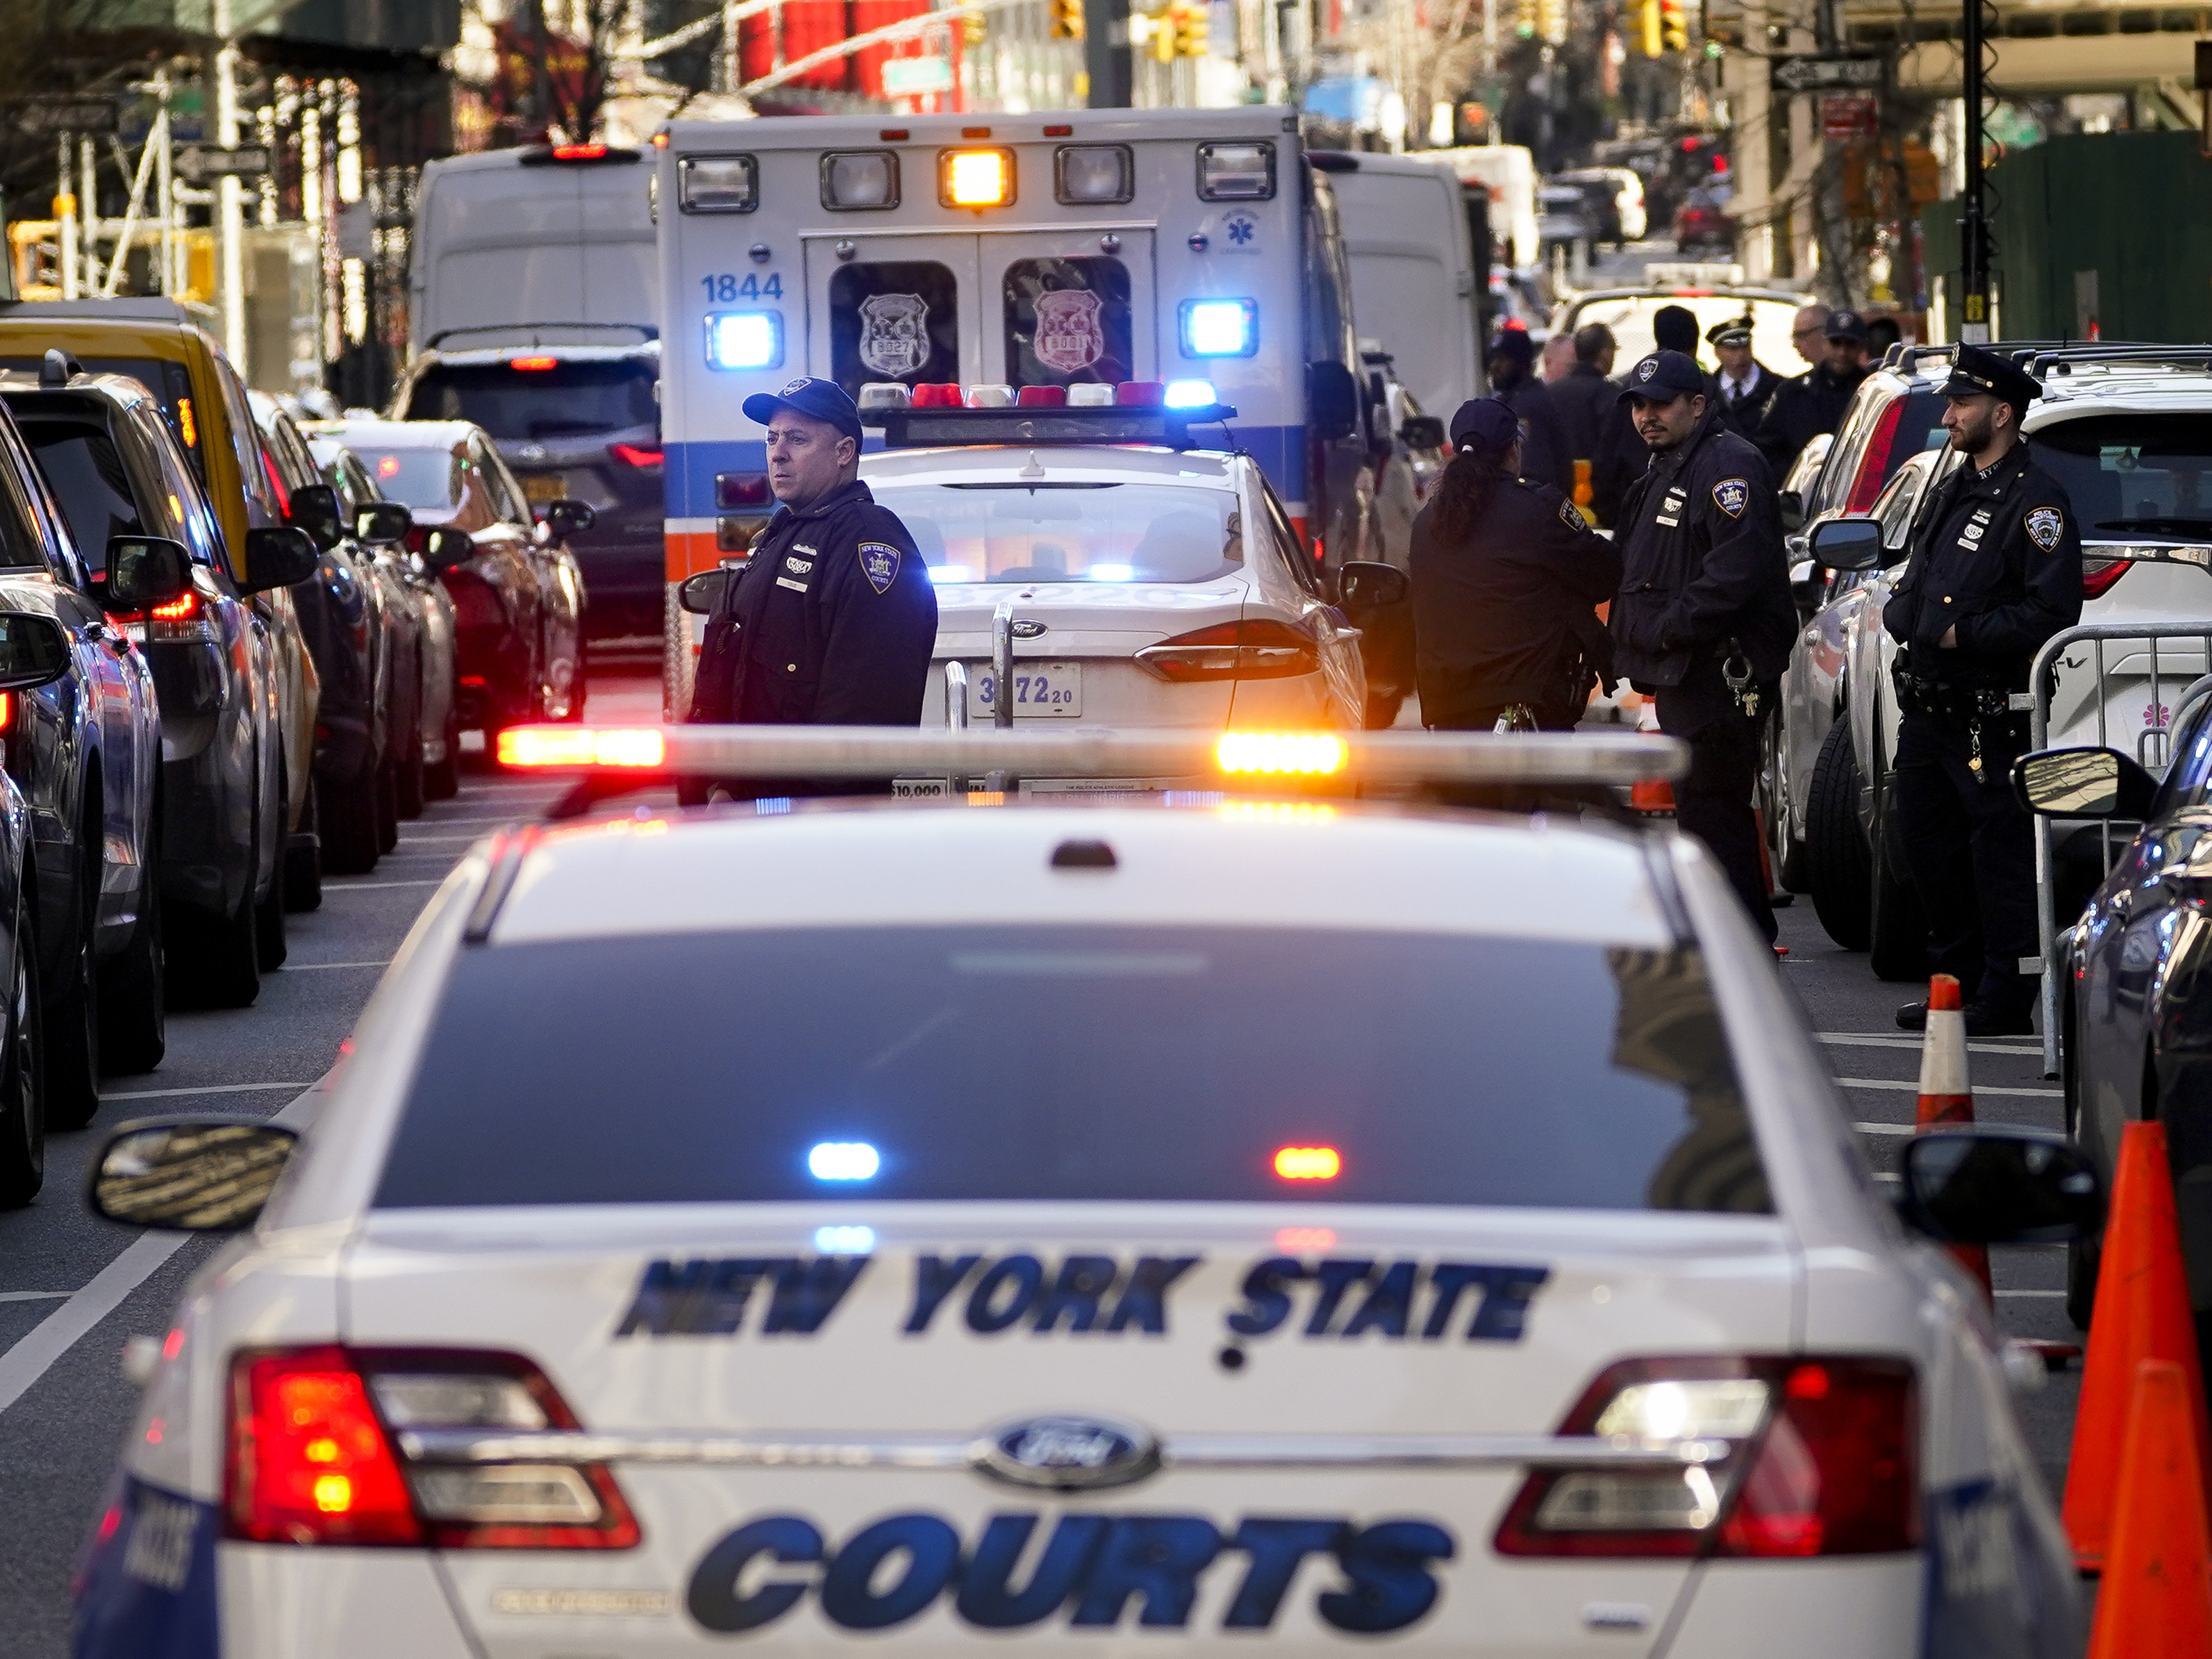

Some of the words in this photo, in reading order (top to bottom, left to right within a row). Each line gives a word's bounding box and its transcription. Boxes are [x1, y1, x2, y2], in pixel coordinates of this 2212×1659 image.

[701, 272, 783, 302] 1844
[979, 676, 1049, 703] 372
[612, 1256, 875, 1337] NEW
[901, 1253, 1207, 1336] YORK
[1226, 1258, 1552, 1344] STATE
[1017, 1427, 1111, 1468] Ford
[685, 1514, 1458, 1634] COURTS
